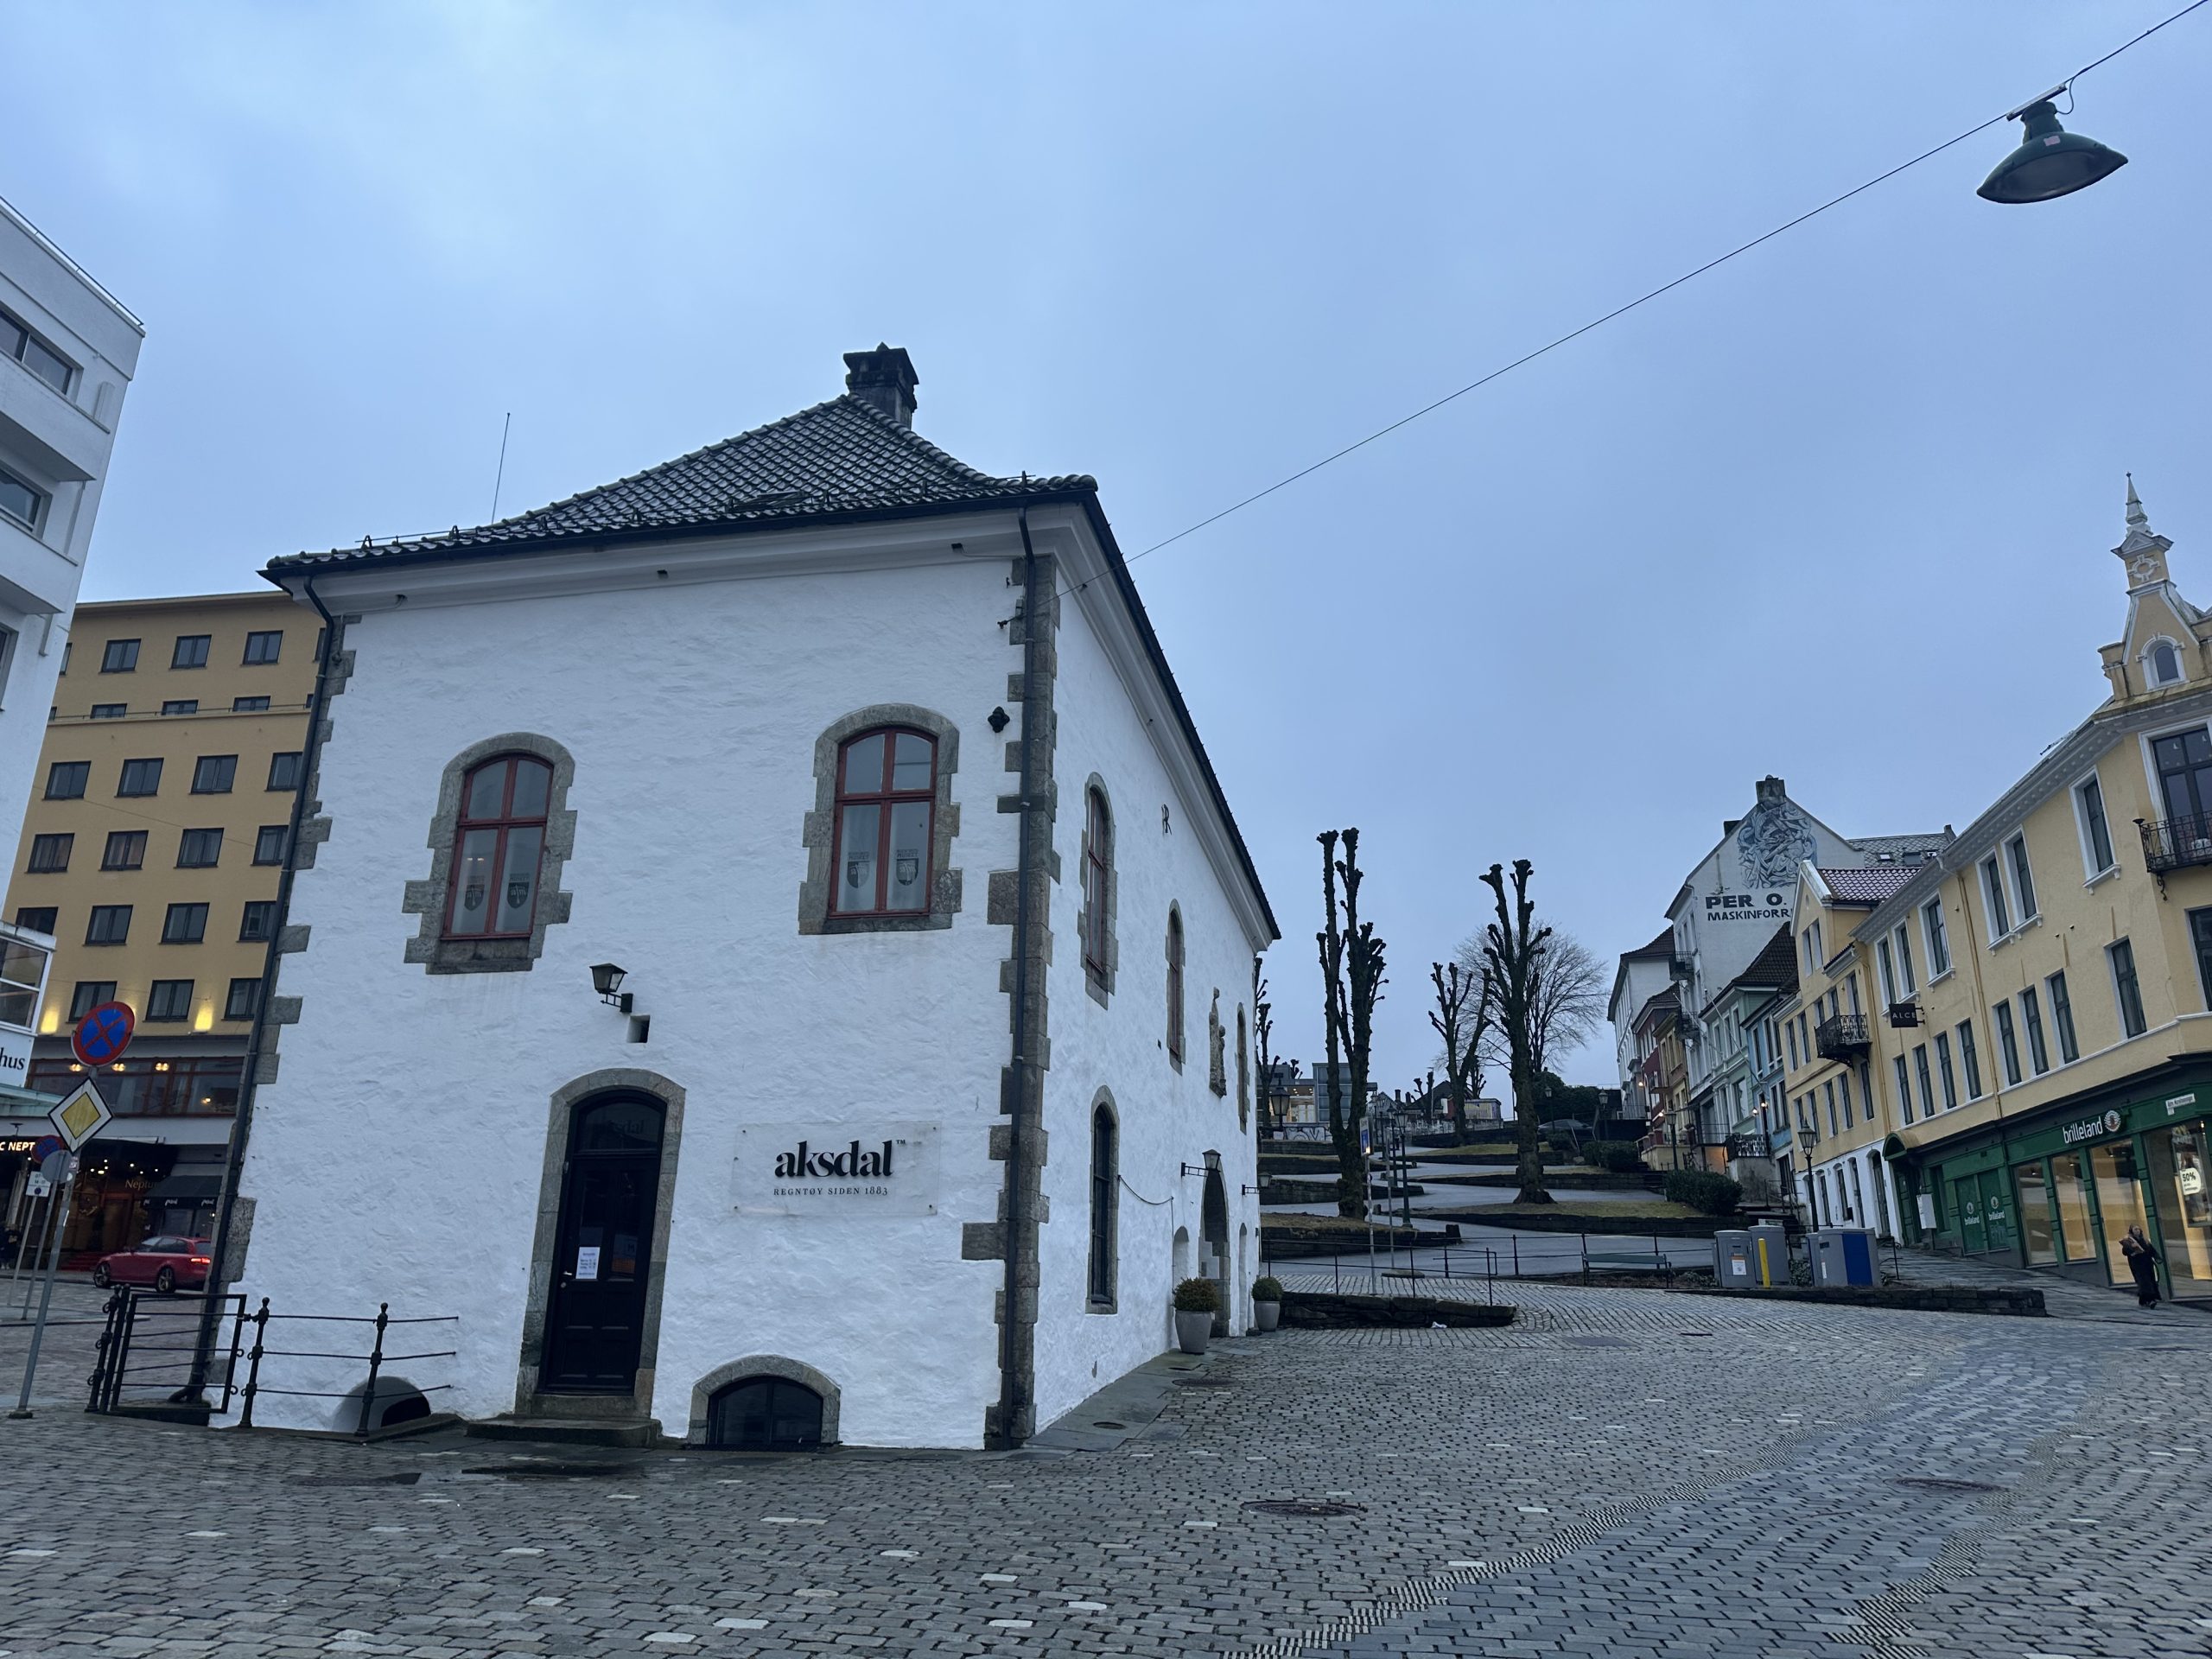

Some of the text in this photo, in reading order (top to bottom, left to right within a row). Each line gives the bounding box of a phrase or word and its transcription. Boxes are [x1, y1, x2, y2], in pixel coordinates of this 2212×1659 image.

[1706, 893, 1787, 909] PER O.
[1707, 908, 1792, 921] MASKINFORR
[0, 1047, 25, 1071] hus
[2063, 1116, 2103, 1144] brilleland
[774, 1140, 893, 1178] aksdal
[2183, 1173, 2196, 1182] 50%
[773, 1187, 823, 1196] REGNTØY
[865, 1186, 888, 1196] 1883
